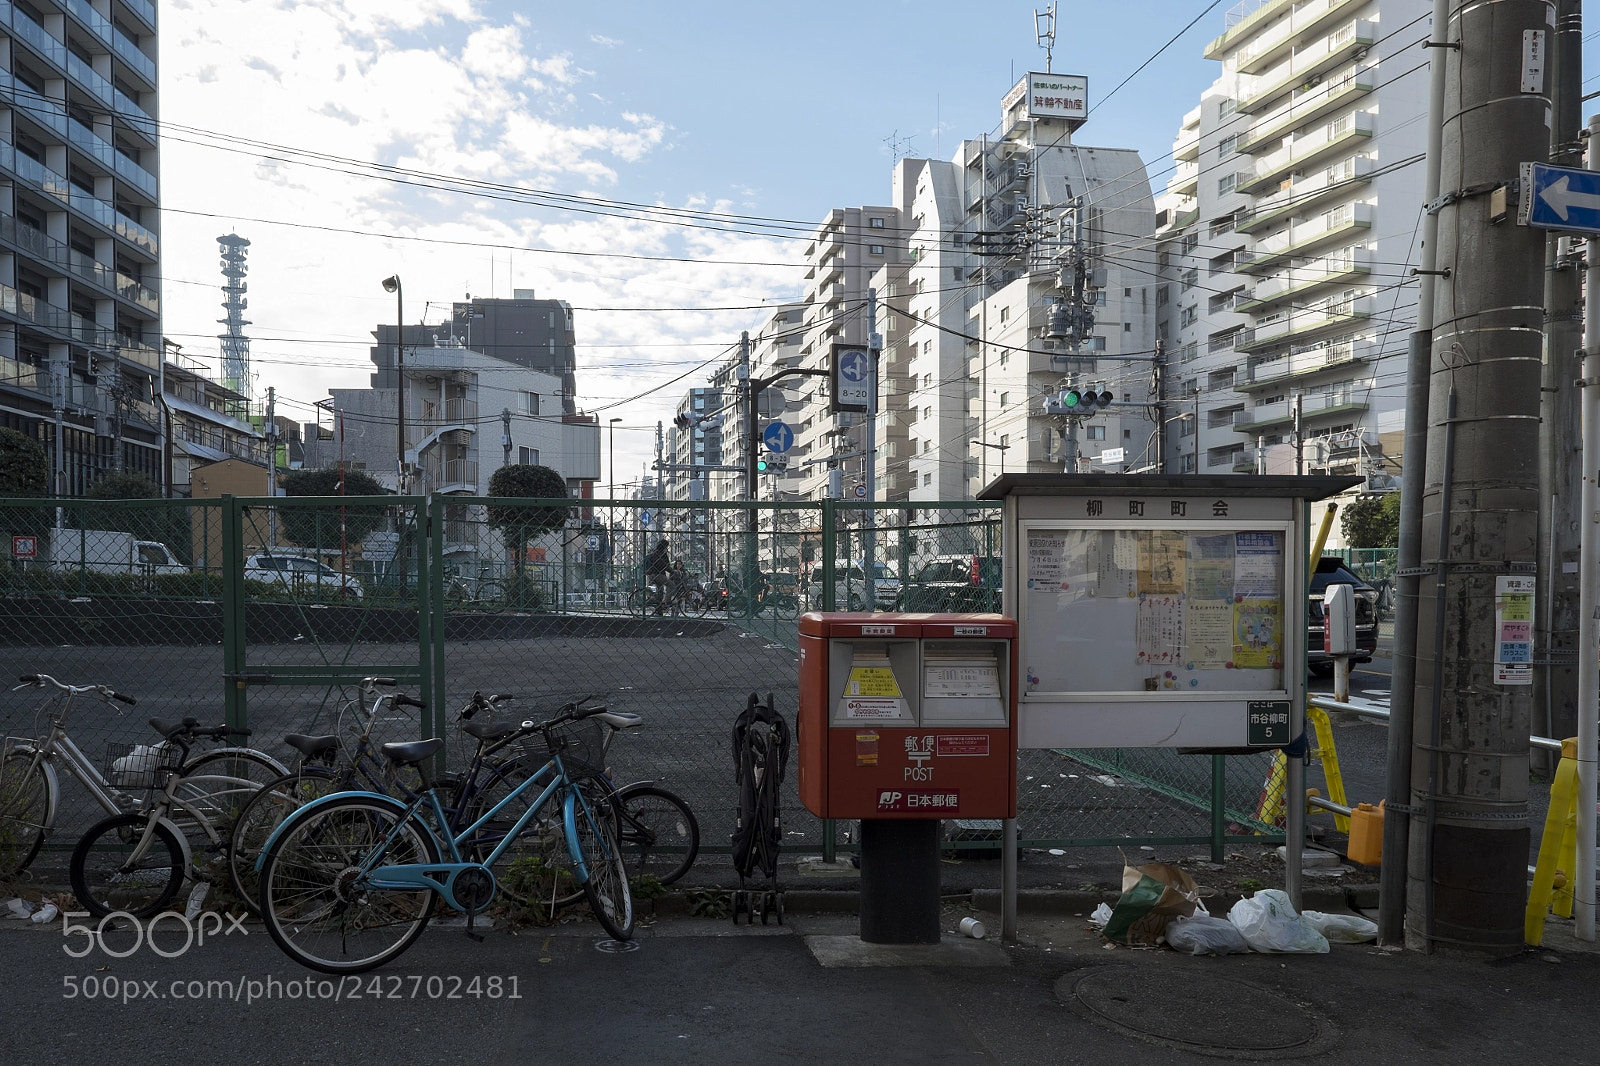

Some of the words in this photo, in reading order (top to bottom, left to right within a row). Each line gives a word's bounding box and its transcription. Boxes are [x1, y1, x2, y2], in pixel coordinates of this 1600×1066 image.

[1033, 81, 1084, 91] 住まいのパートナー
[1034, 95, 1083, 110] 箕輪不動産
[842, 389, 867, 397] 8-20
[1086, 500, 1229, 517] 柳町町会
[1250, 713, 1288, 724] 市谷柳町
[1265, 727, 1273, 738] 5
[904, 735, 935, 752] 郵便
[904, 767, 934, 781] POST
[907, 794, 958, 807] 日本郵便
